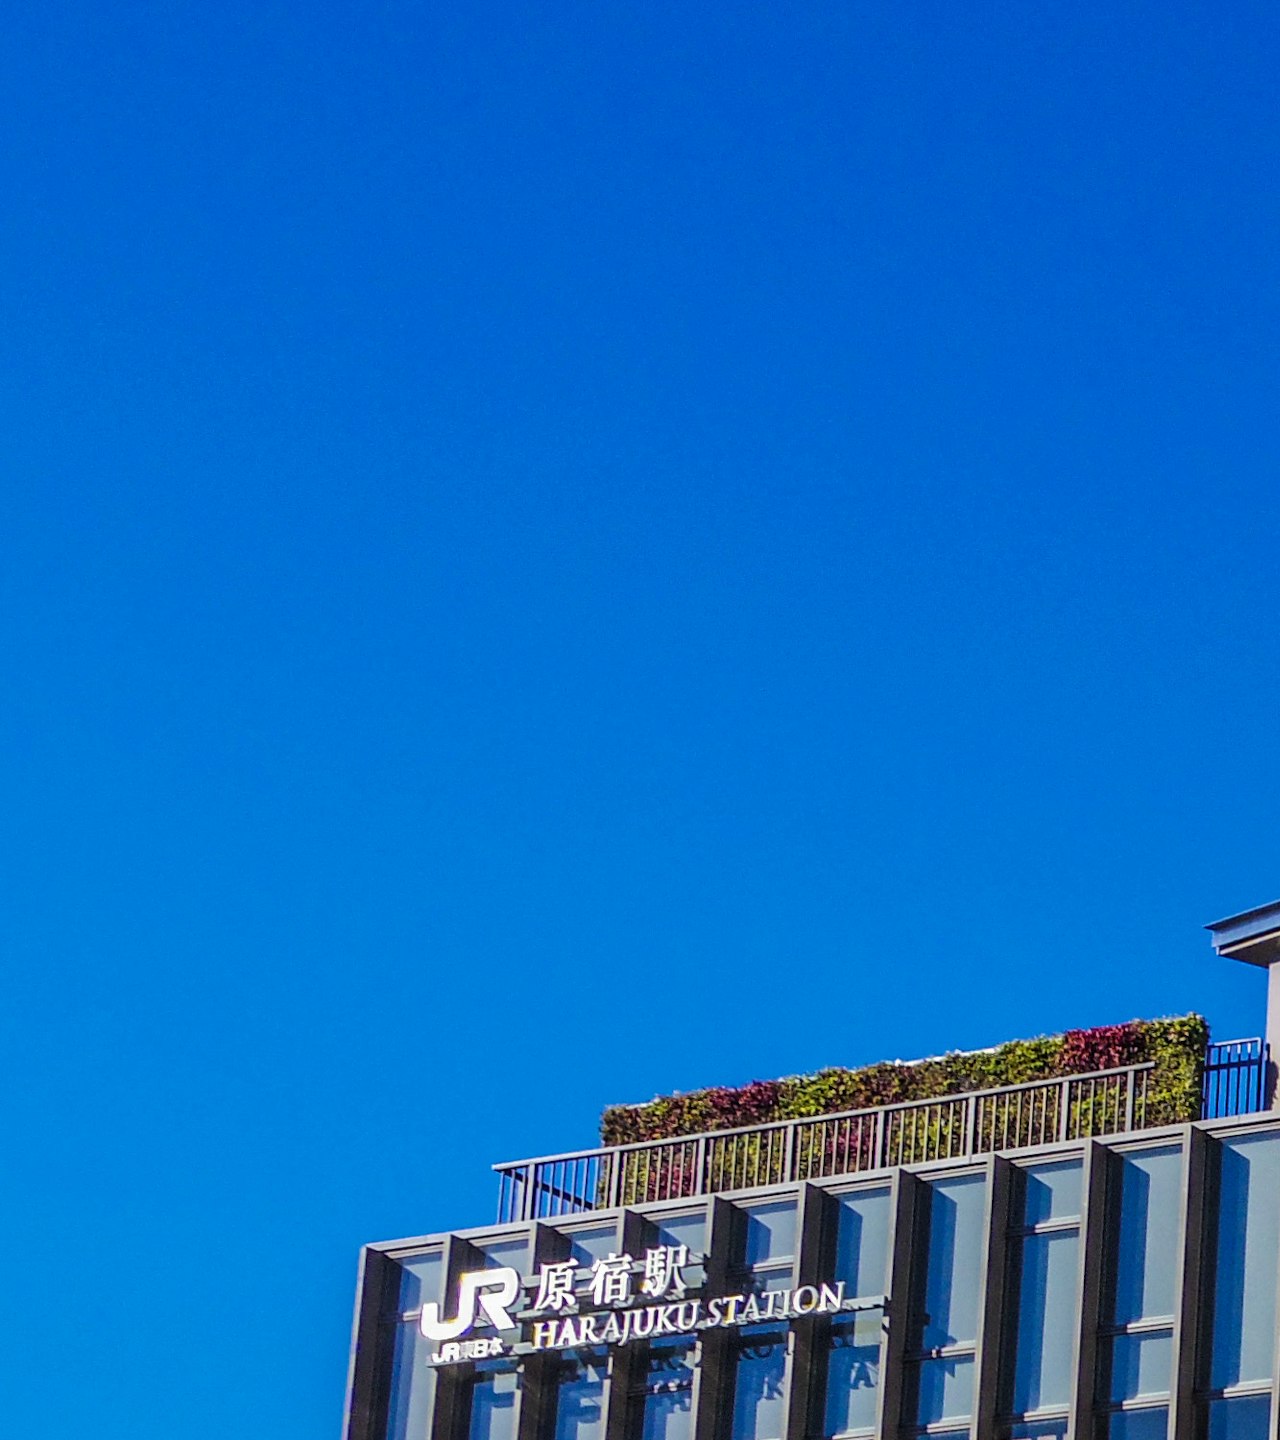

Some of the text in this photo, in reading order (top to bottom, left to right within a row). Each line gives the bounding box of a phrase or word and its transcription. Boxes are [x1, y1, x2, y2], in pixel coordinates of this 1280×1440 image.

[420, 1266, 520, 1341] JR
[534, 1244, 690, 1312] 原宿駅
[533, 1280, 847, 1350] HARAJUKU STATION
[430, 1336, 504, 1364] JR東日本
